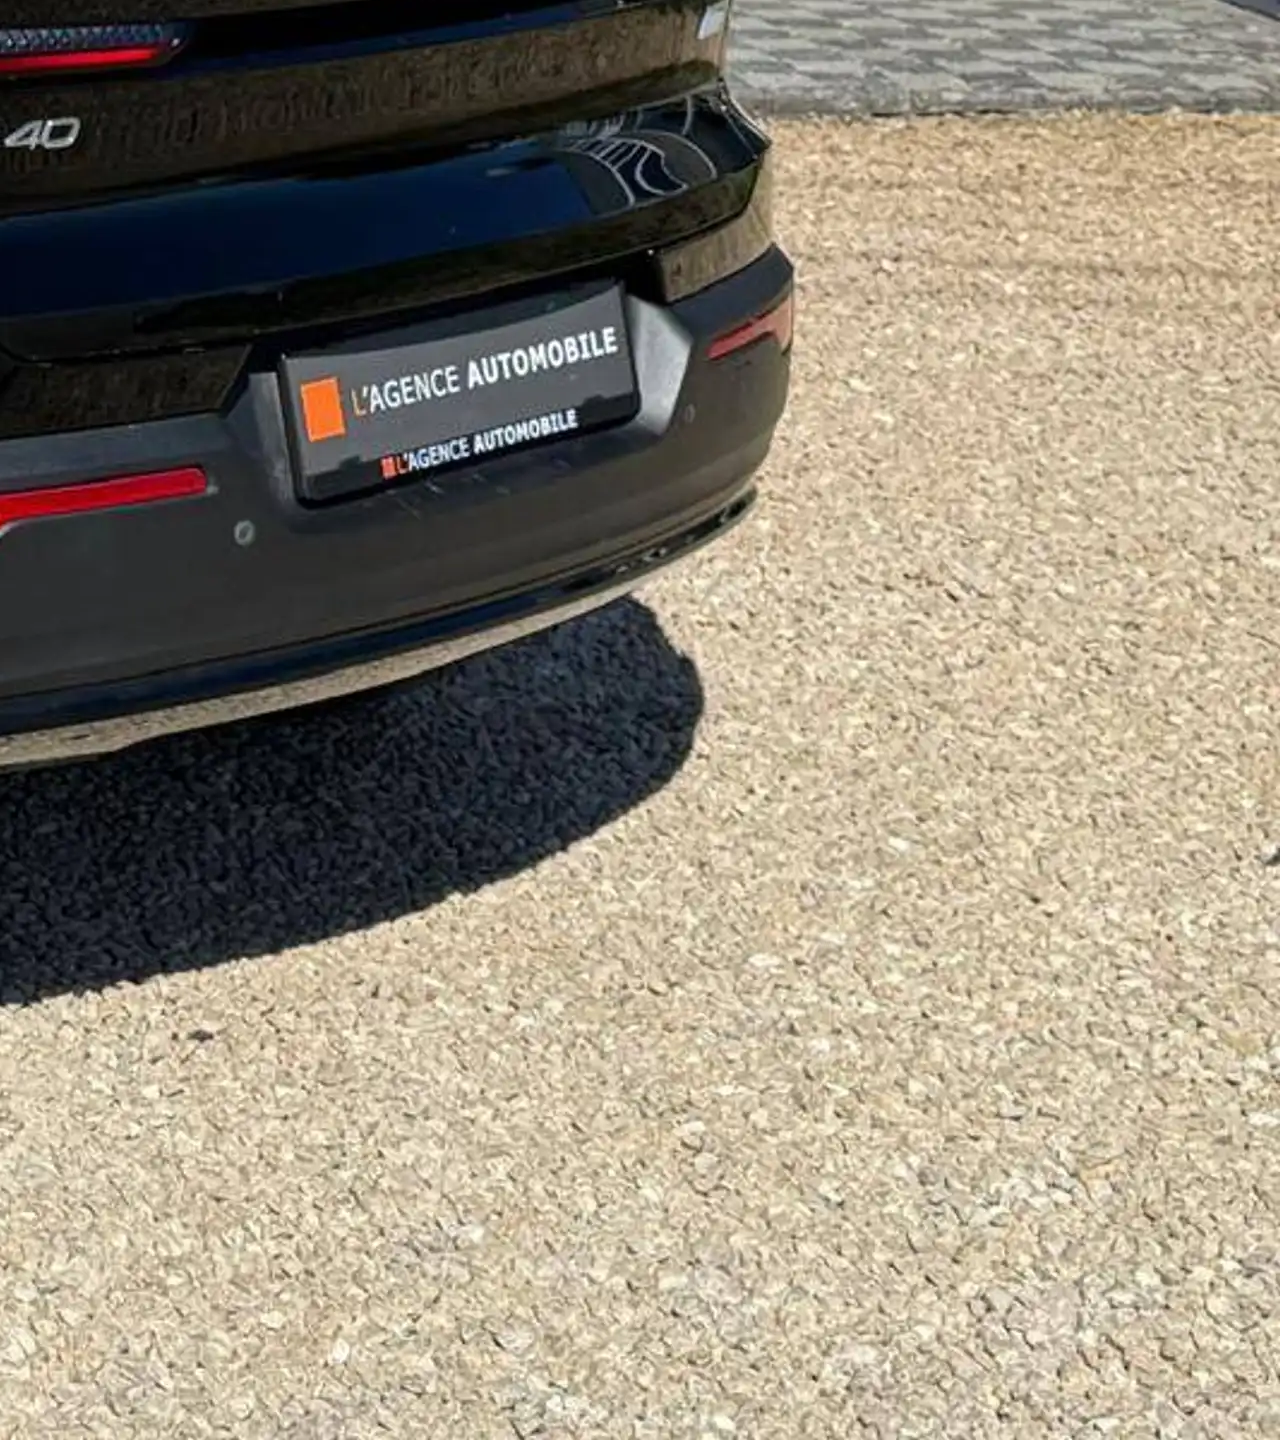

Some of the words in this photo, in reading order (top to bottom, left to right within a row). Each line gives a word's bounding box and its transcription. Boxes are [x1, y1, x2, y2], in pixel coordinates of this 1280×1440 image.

[350, 368, 461, 418] L'AGENCE
[467, 326, 619, 391] AUTOMOBILE
[395, 438, 470, 474] L'AGENCE
[473, 409, 579, 453] AUTOMOBILE
